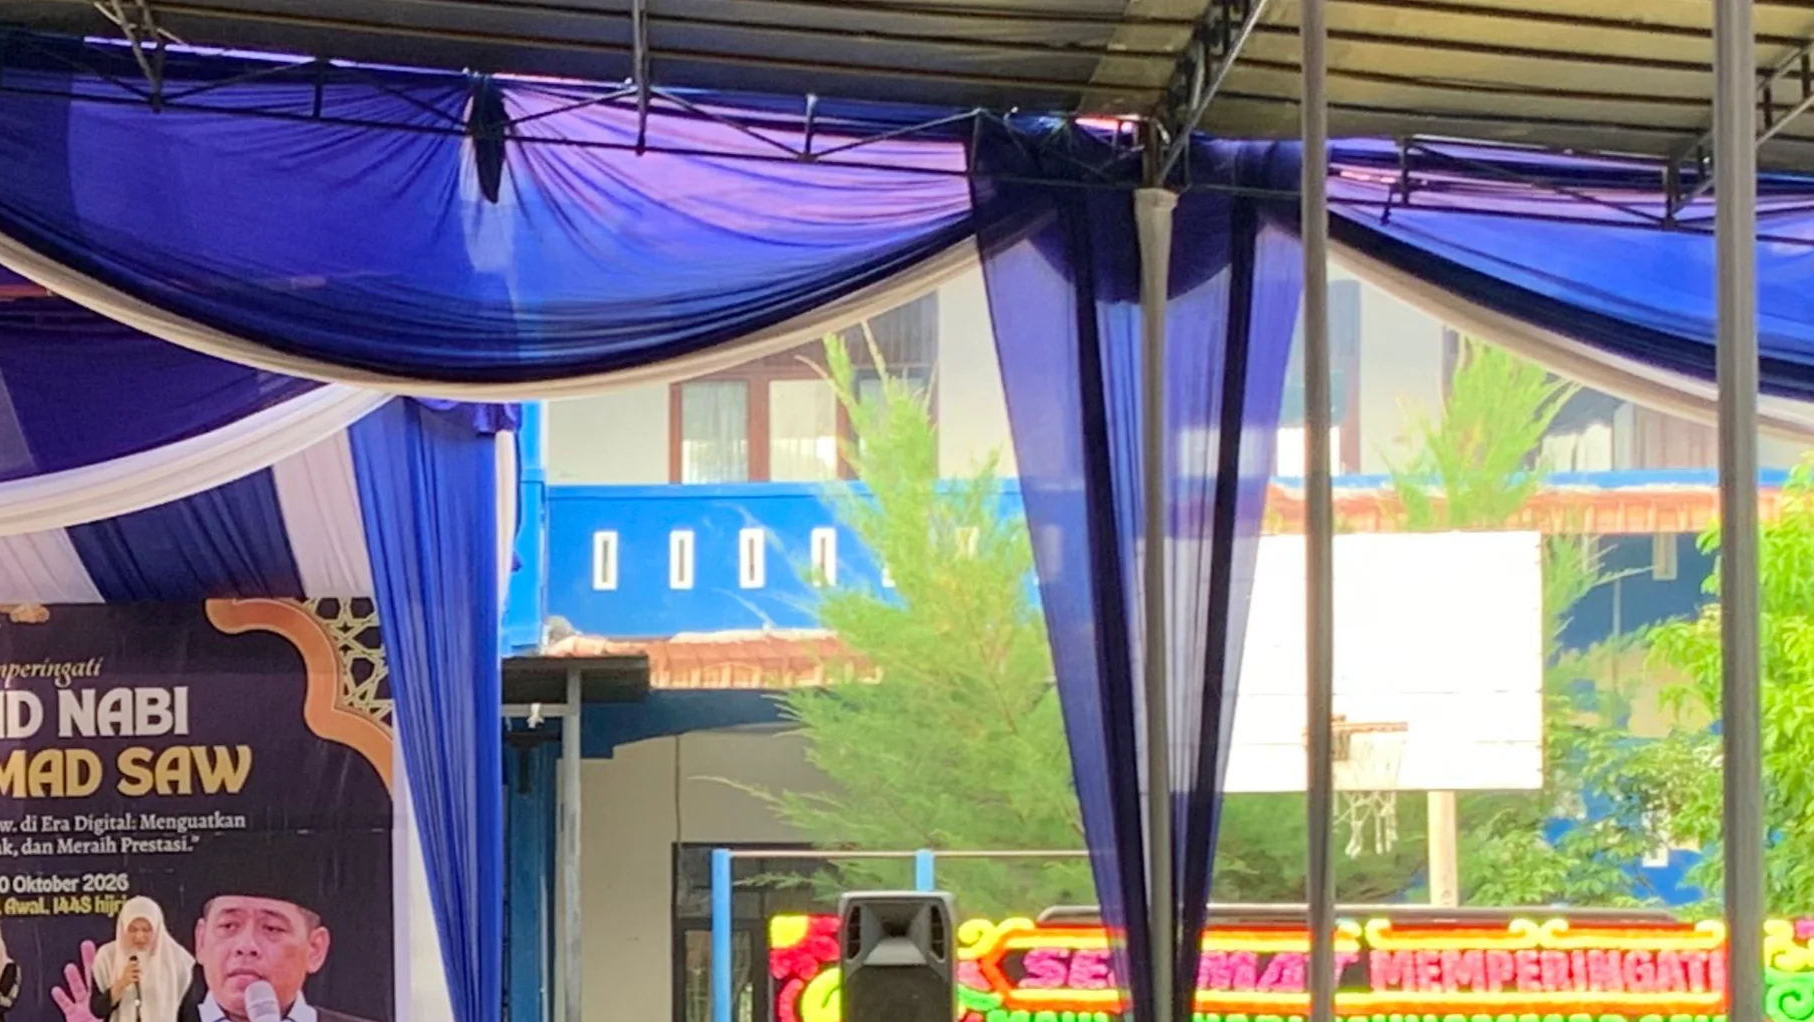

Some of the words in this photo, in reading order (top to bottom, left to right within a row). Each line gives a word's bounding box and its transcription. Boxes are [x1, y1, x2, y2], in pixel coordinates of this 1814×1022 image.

[58, 686, 189, 738] NABI
[116, 745, 252, 796] SAW
[20, 815, 37, 833] di
[41, 815, 70, 832] Era
[74, 812, 136, 835] Digital:
[139, 810, 247, 834] Menguatkan
[21, 838, 54, 855] dan
[56, 836, 117, 855] Meraih
[13, 874, 79, 893] Oktober
[82, 873, 130, 892] 2026
[1370, 949, 1726, 993] MEMPERINGATI
